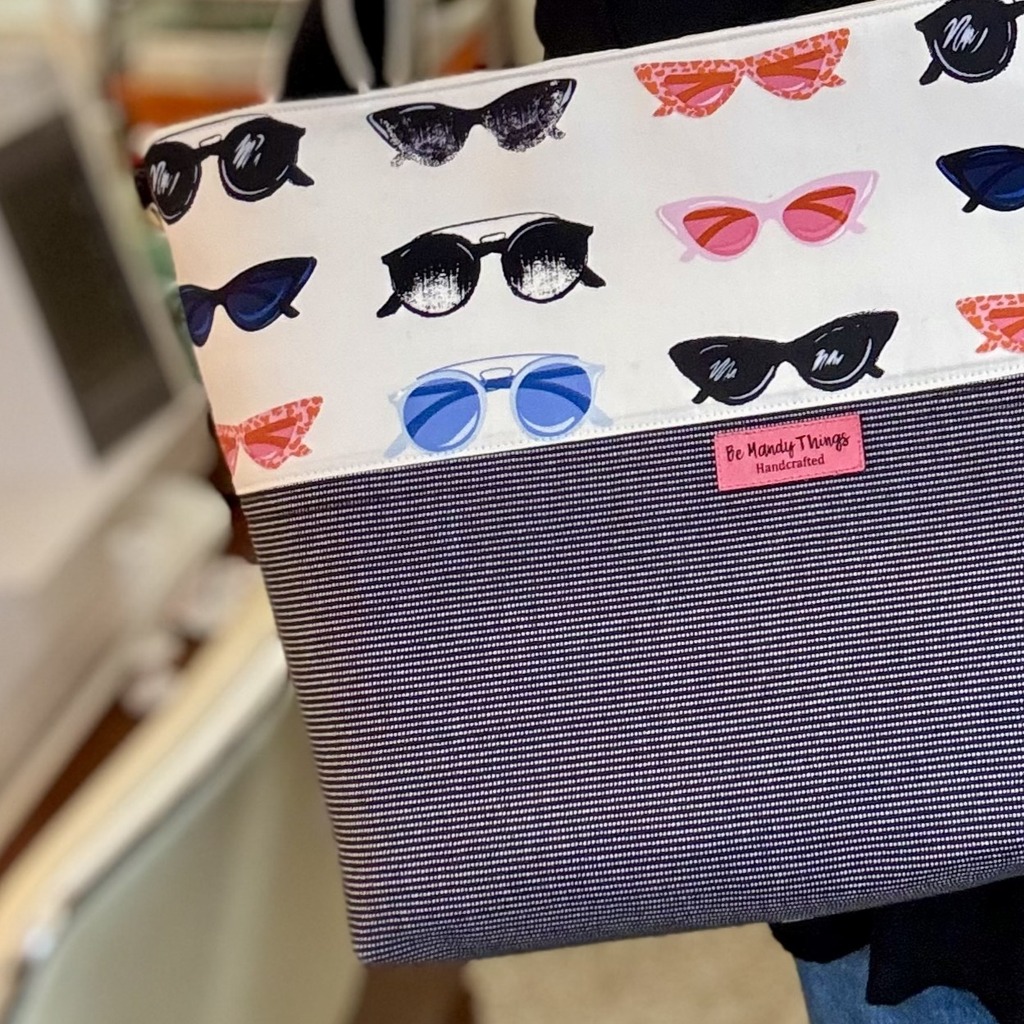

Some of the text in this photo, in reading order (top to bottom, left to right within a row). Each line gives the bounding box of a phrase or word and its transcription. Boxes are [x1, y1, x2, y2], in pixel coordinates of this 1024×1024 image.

[726, 432, 850, 462] Be Mandy Things
[756, 453, 825, 474] Handcrafted
